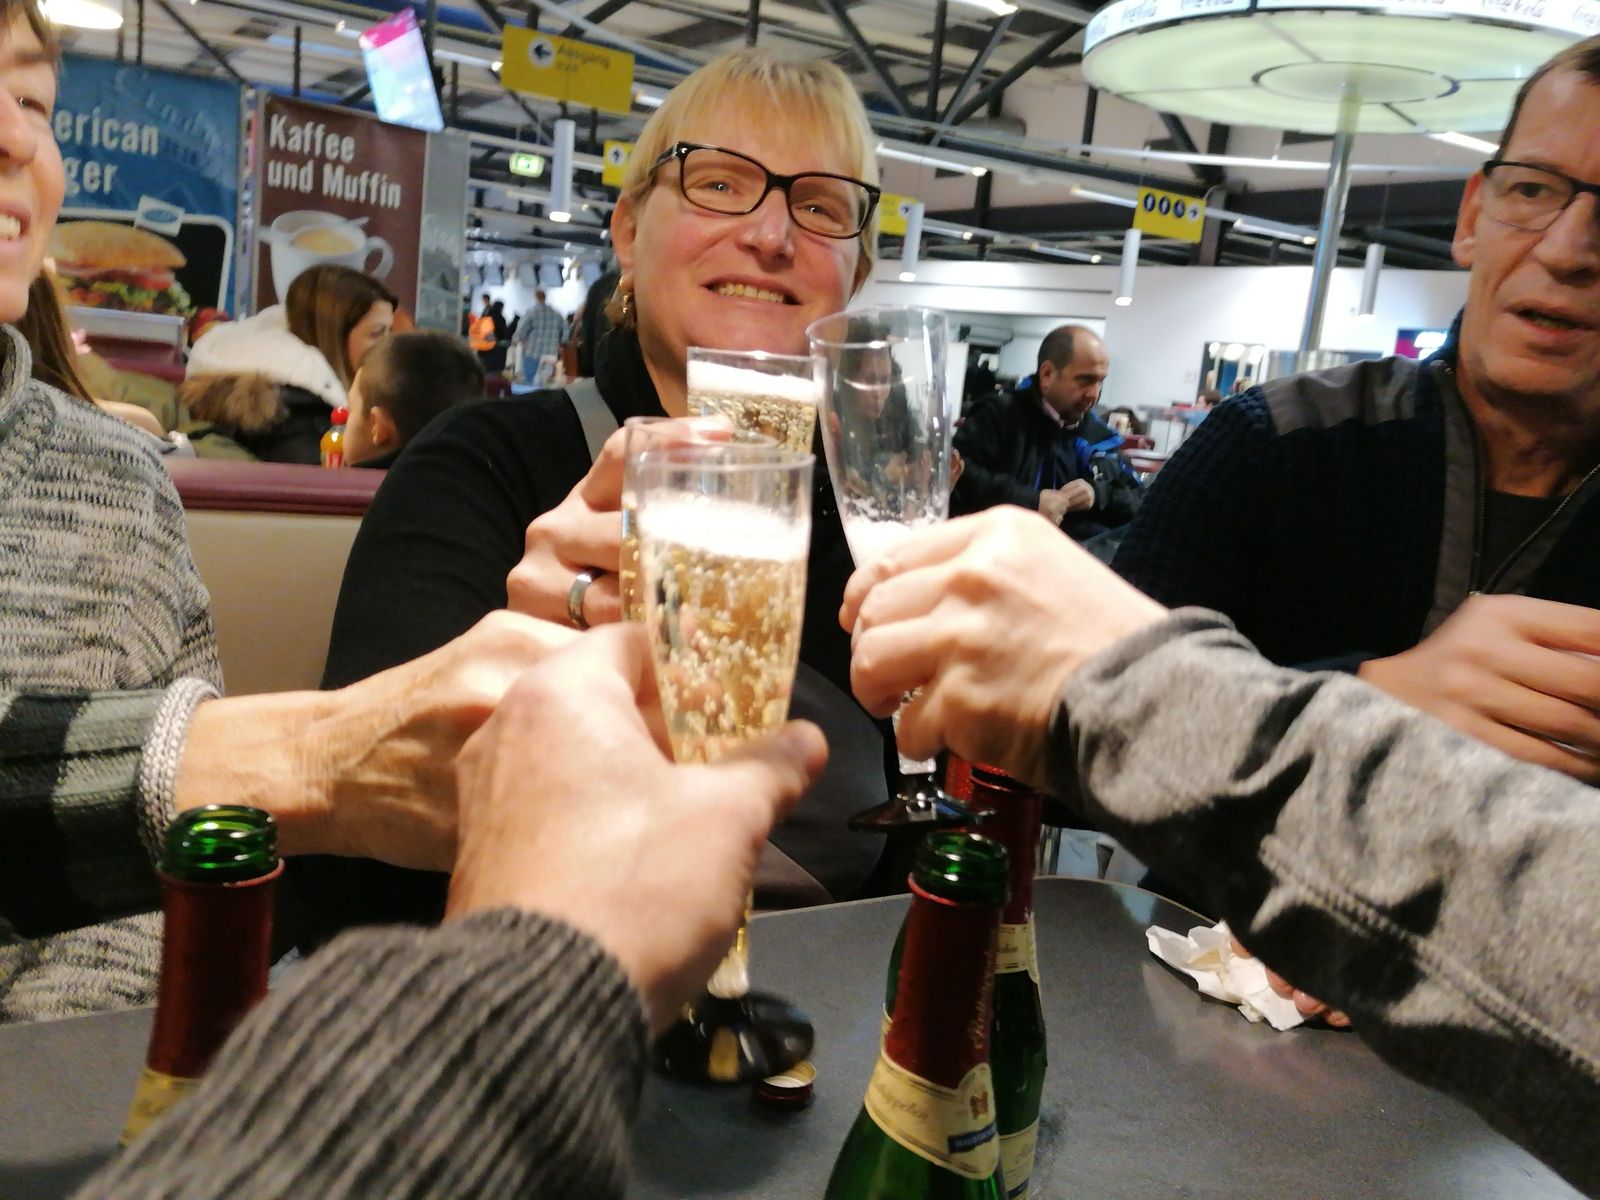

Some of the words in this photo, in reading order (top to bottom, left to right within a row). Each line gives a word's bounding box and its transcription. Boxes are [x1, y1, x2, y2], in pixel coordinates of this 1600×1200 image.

[54, 106, 159, 156] erican
[269, 113, 355, 163] Kaffee
[63, 156, 118, 197] ger
[267, 159, 314, 194] und
[322, 162, 401, 209] Muffin
